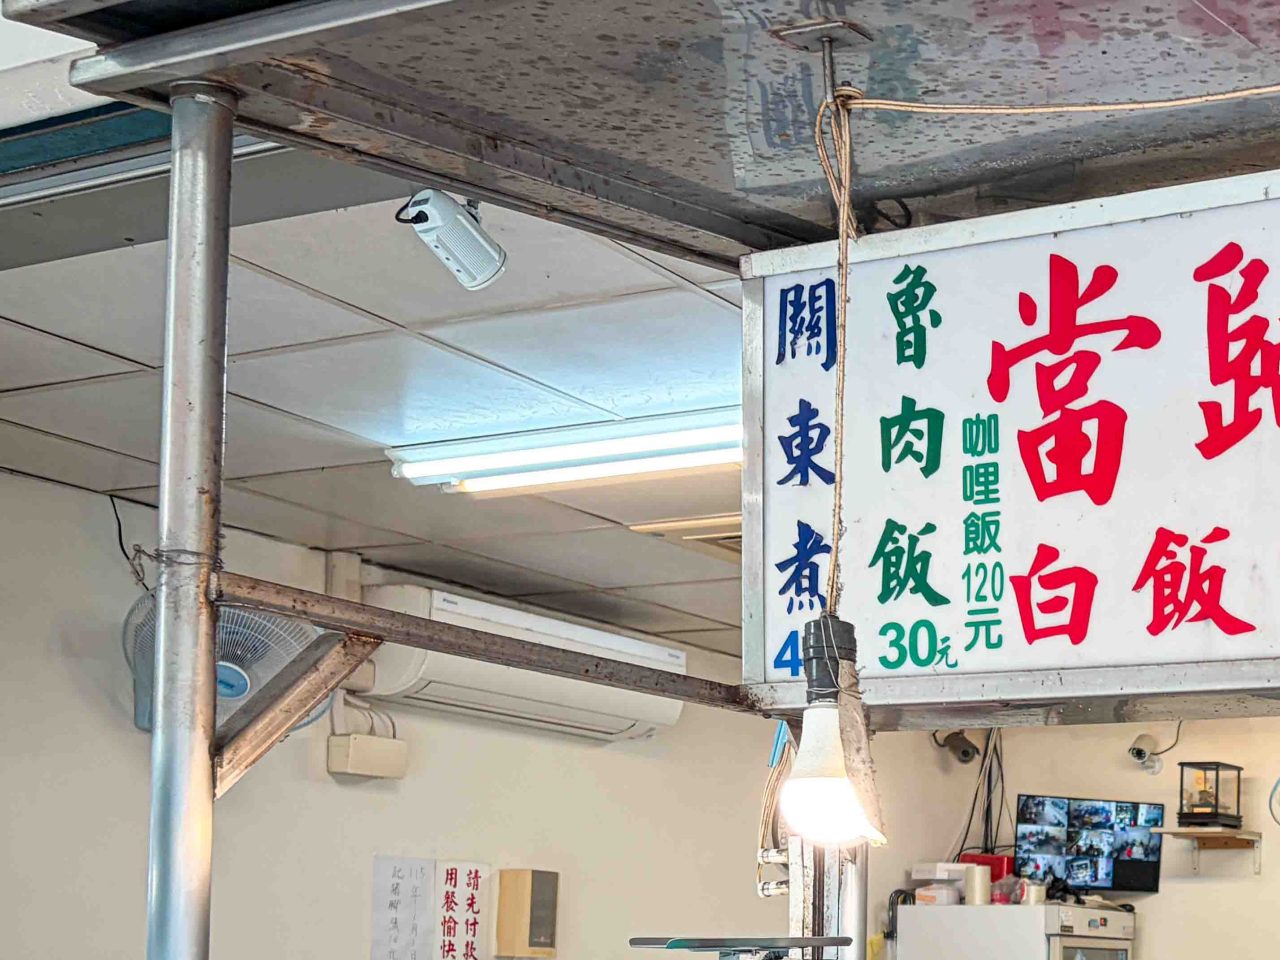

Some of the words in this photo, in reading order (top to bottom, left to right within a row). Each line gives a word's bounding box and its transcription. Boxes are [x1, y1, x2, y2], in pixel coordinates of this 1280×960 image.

[775, 276, 837, 615] 關東煮
[440, 867, 459, 960] 用餐愉快
